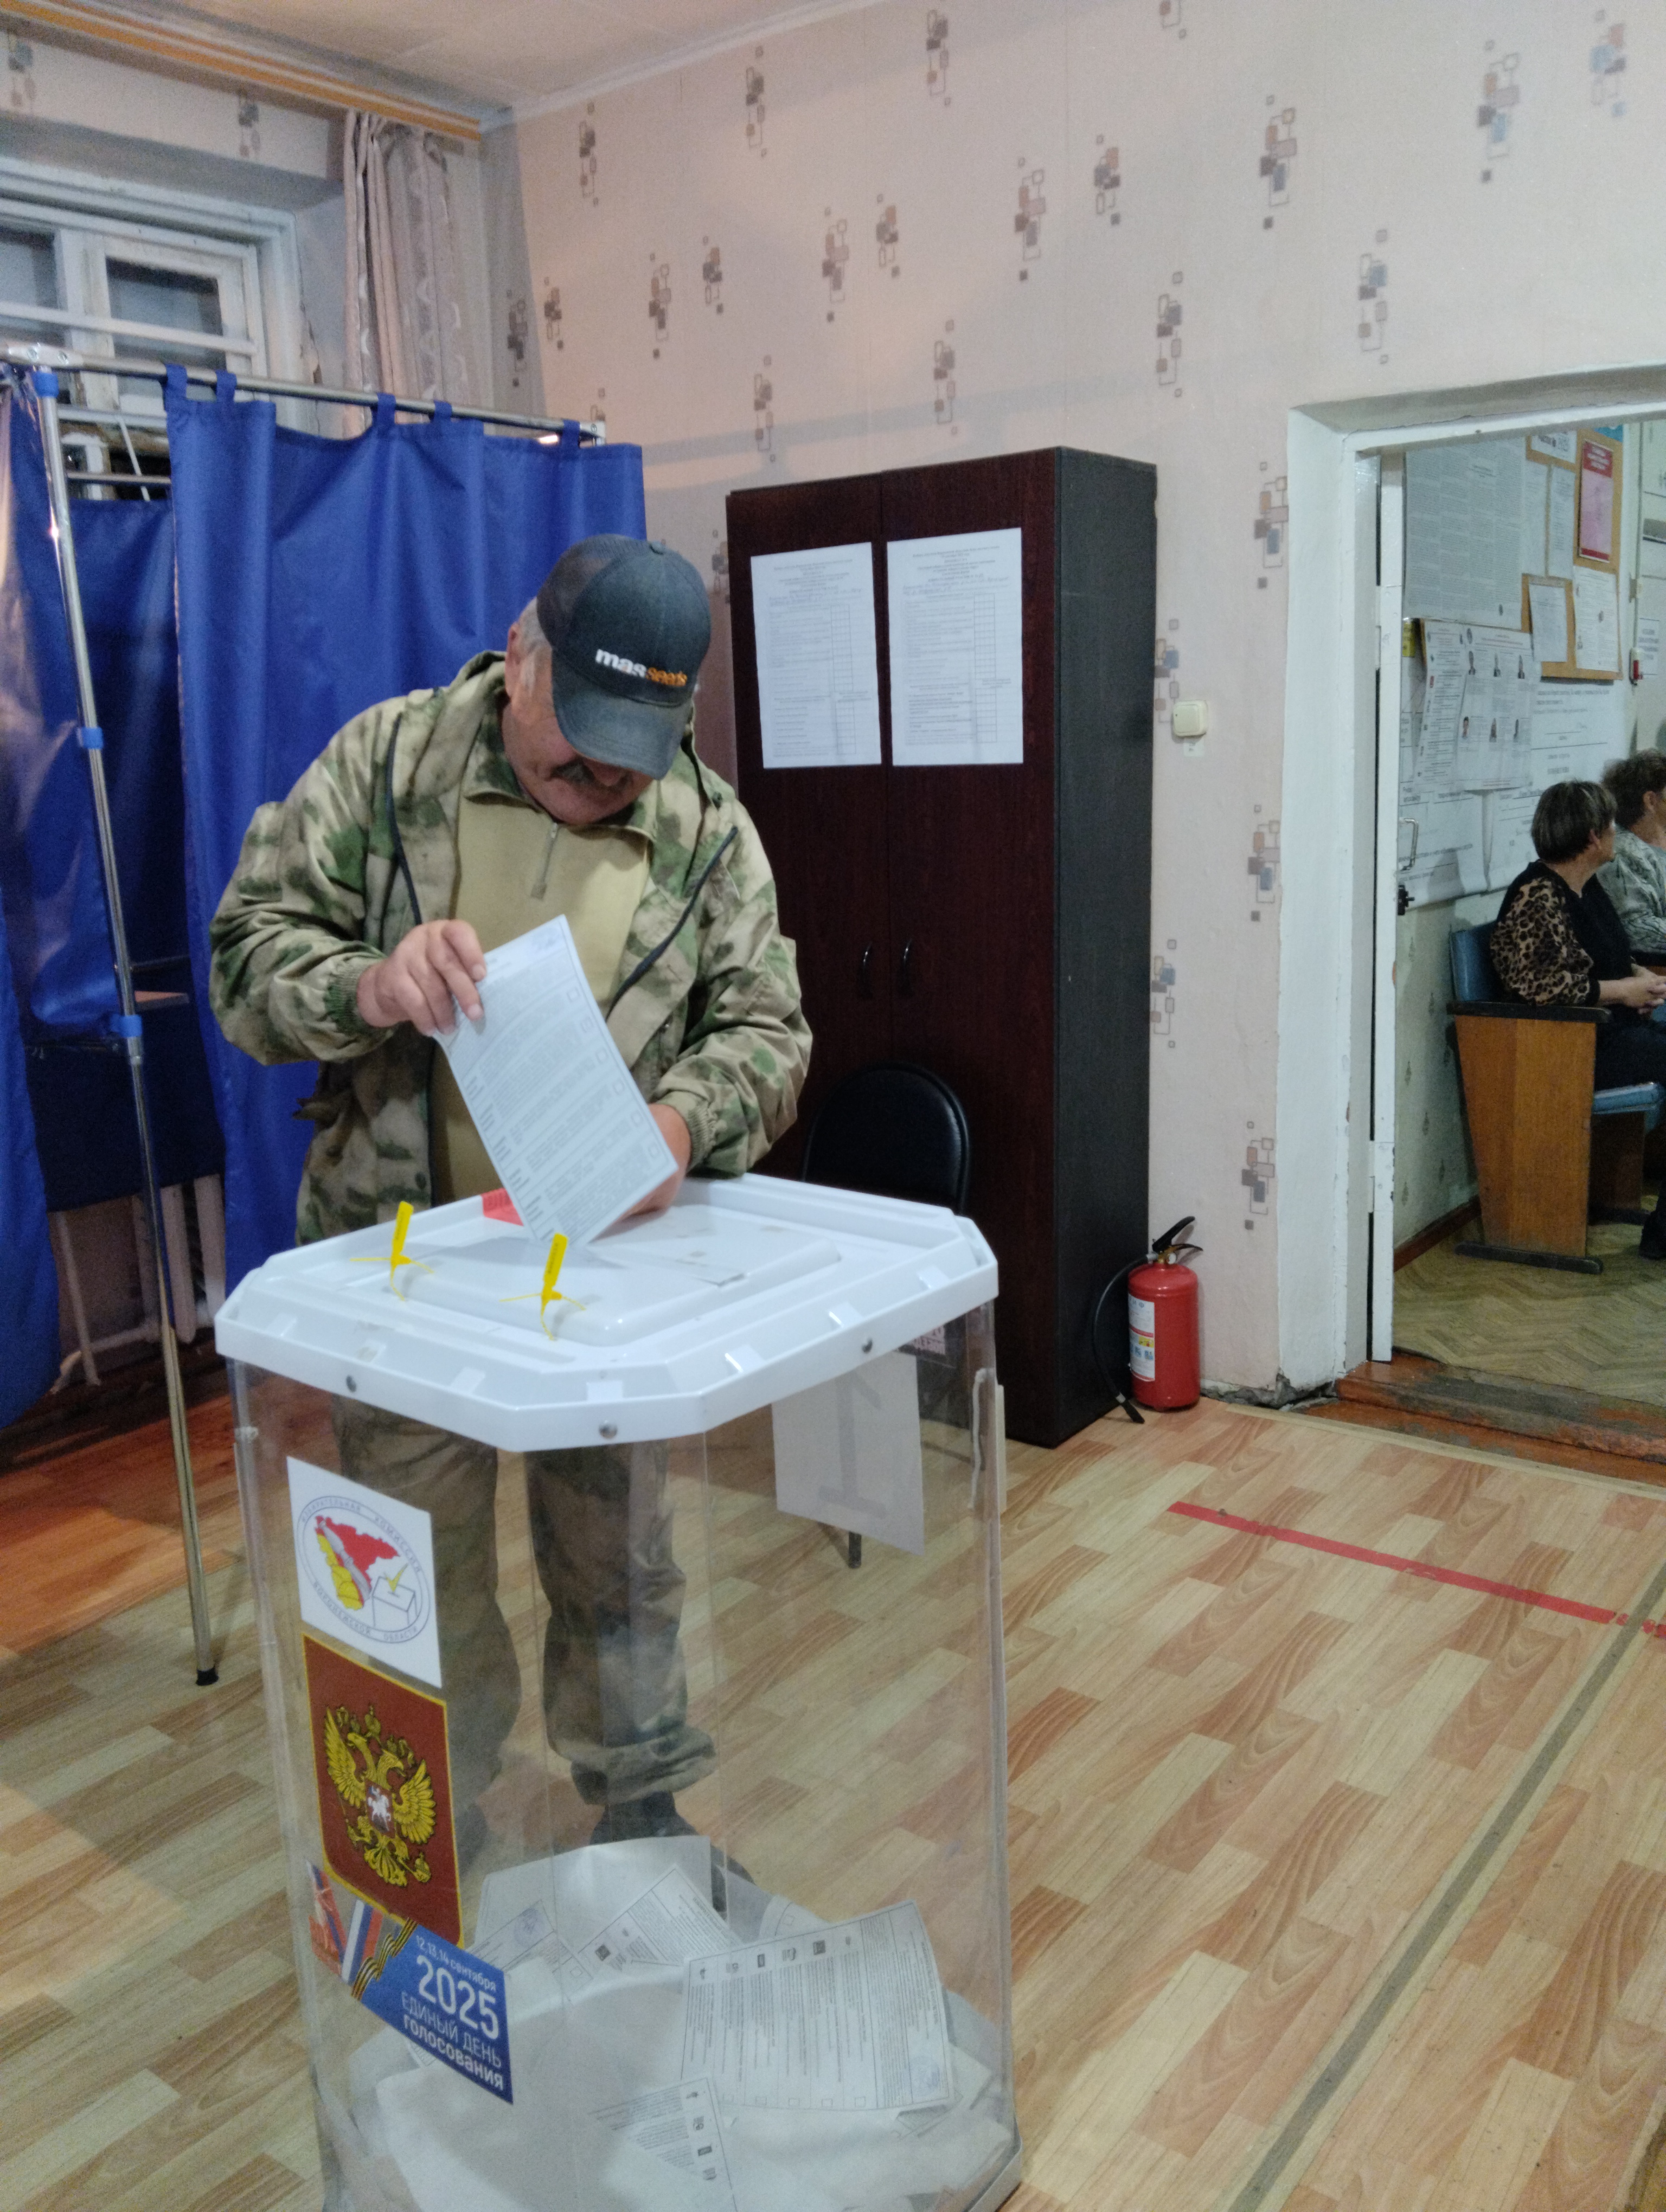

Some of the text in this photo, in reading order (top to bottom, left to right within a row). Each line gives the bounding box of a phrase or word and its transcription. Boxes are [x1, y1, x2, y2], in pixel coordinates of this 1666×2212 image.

[416, 1955, 499, 2040] 2025
[450, 1959, 496, 1991] сентября
[402, 1991, 502, 2068] ЕДИНЫЙ ДЕНЬ
[403, 2014, 504, 2091] голосования
